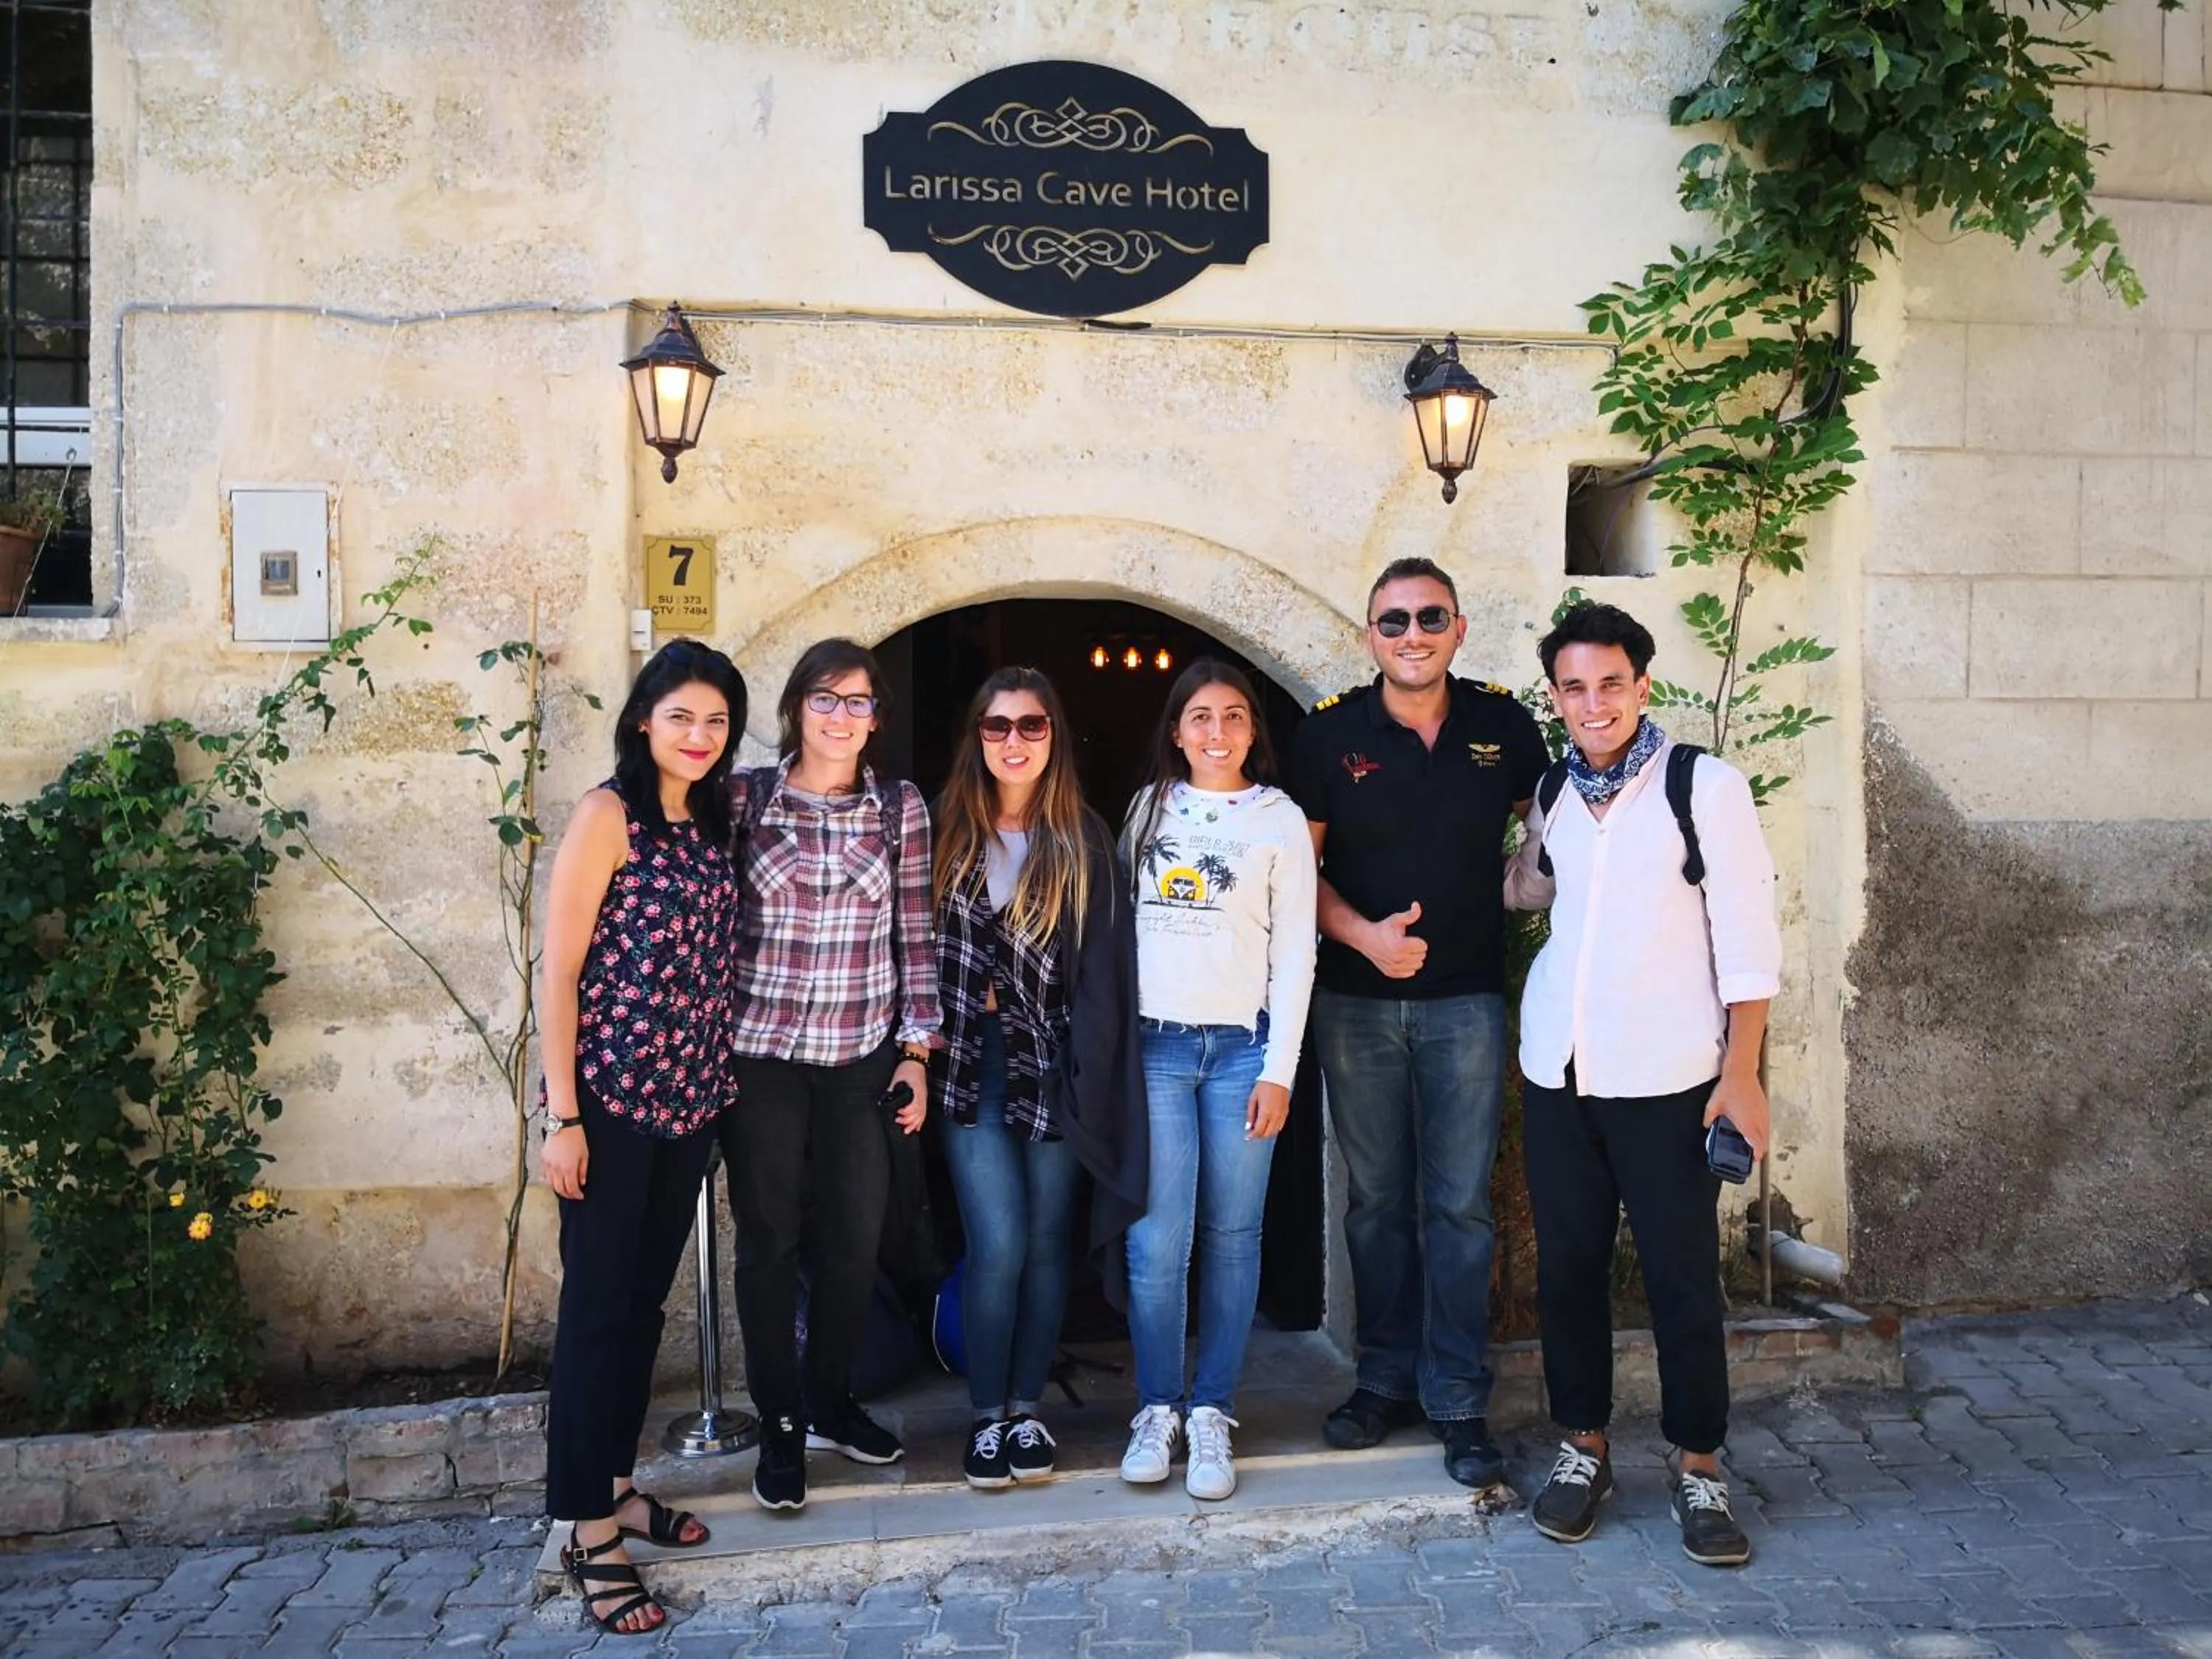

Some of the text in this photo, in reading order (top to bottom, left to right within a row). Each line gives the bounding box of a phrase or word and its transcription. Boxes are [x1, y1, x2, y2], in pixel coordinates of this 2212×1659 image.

[885, 166, 1248, 212] Larissa Cave Hotel
[668, 544, 694, 586] 7
[658, 595, 673, 604] SU
